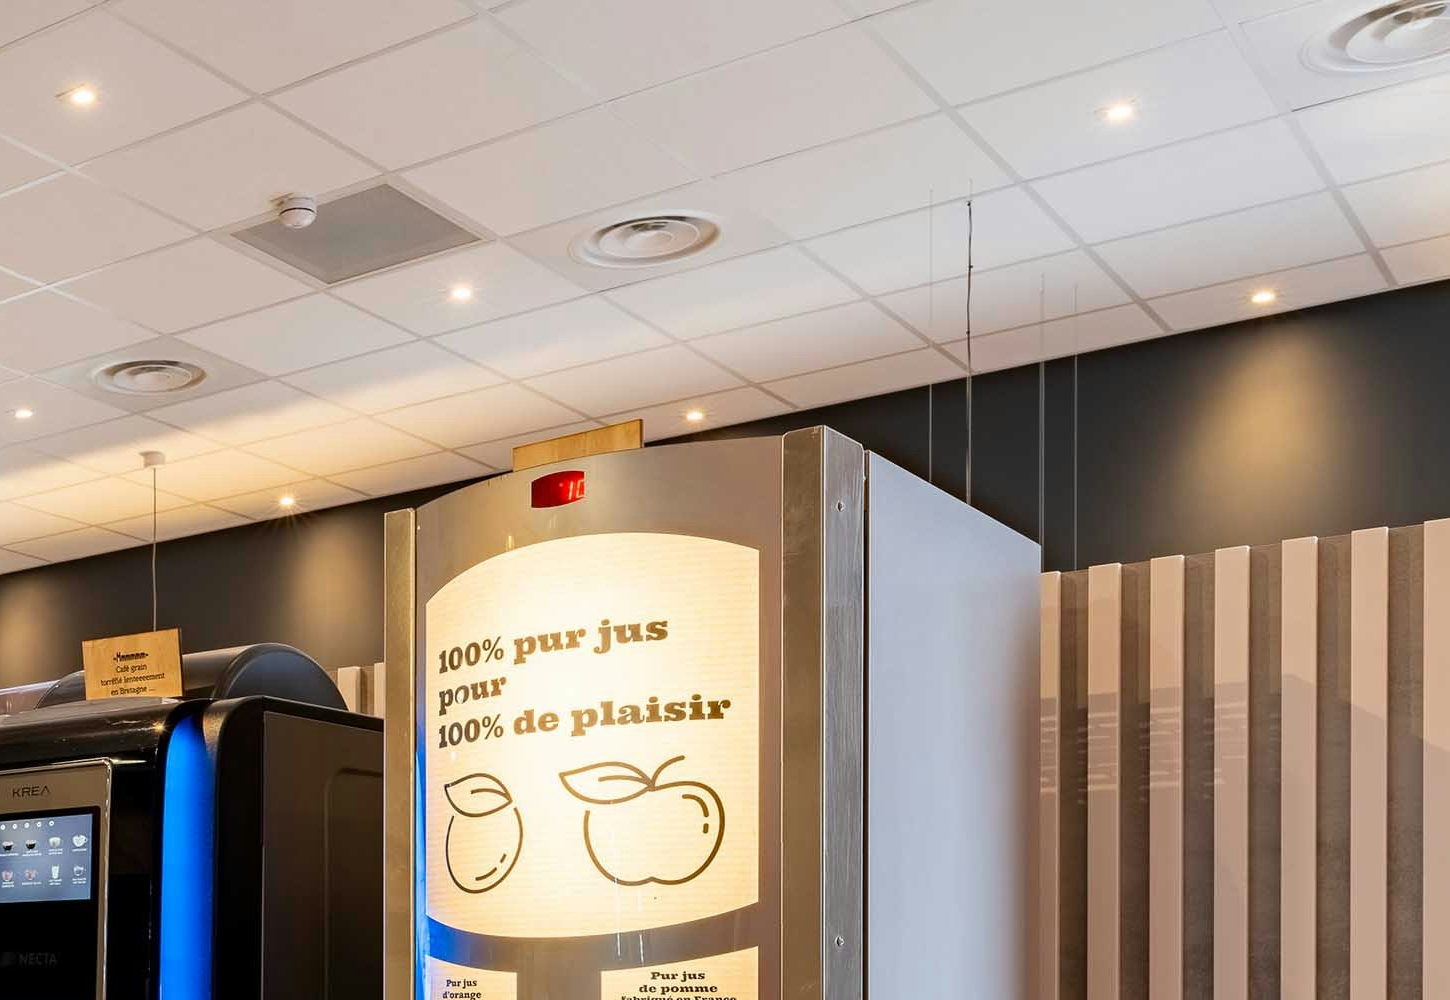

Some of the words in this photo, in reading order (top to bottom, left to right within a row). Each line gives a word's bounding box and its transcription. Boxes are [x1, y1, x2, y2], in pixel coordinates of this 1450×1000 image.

[438, 636, 505, 674] 100%
[513, 628, 587, 665] pur
[593, 618, 669, 655] jus
[438, 676, 507, 716] pour
[438, 713, 504, 749] 100%
[513, 708, 560, 736] de
[571, 693, 732, 737] plaisir
[12, 785, 51, 798] KREA
[19, 952, 58, 966] NECTA
[650, 971, 679, 980] Pur
[680, 970, 706, 983] jus
[446, 979, 461, 988] Pur
[462, 978, 478, 989] jus
[638, 984, 657, 993] de
[660, 985, 718, 995] pomme
[442, 991, 482, 1000] d'orange
